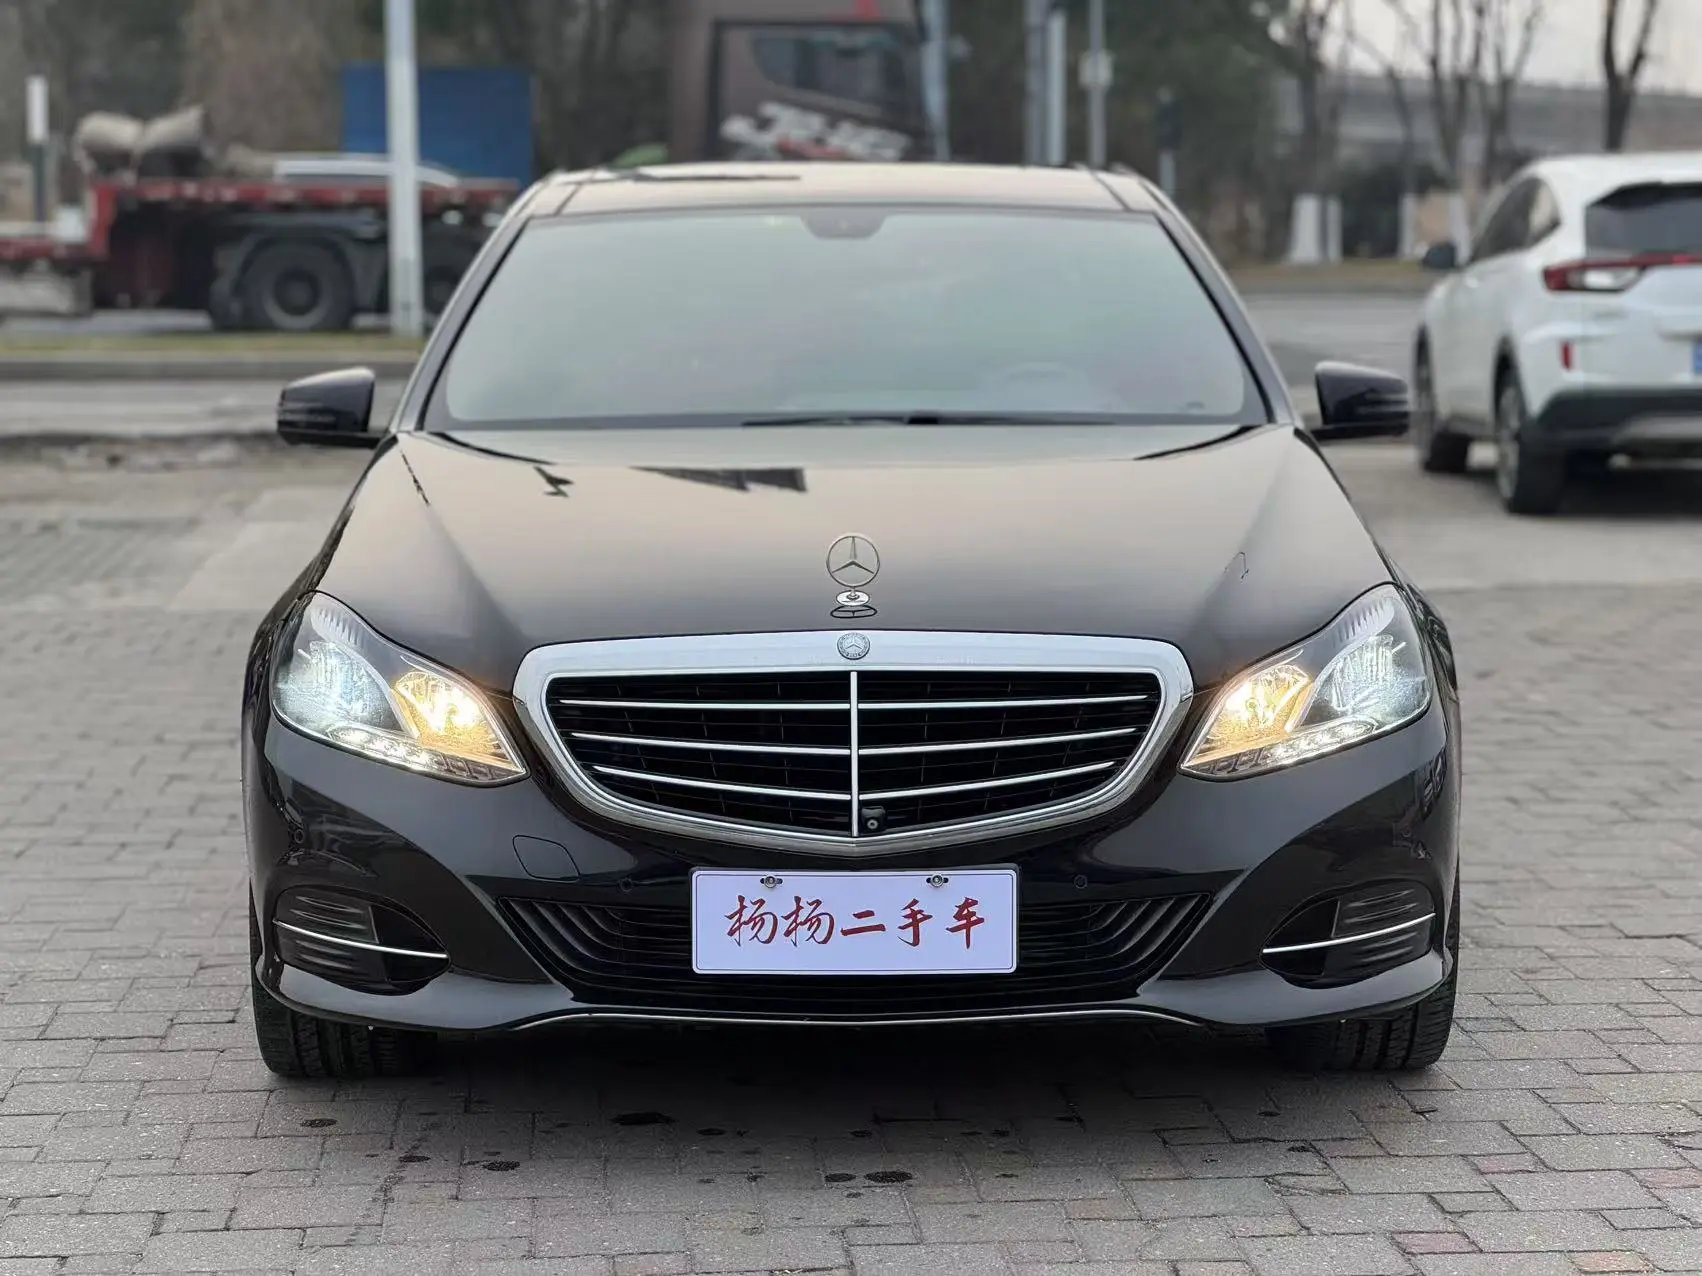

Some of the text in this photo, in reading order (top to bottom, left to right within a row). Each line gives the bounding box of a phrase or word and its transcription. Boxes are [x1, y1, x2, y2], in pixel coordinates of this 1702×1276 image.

[724, 894, 985, 949] 杨杨二手车
